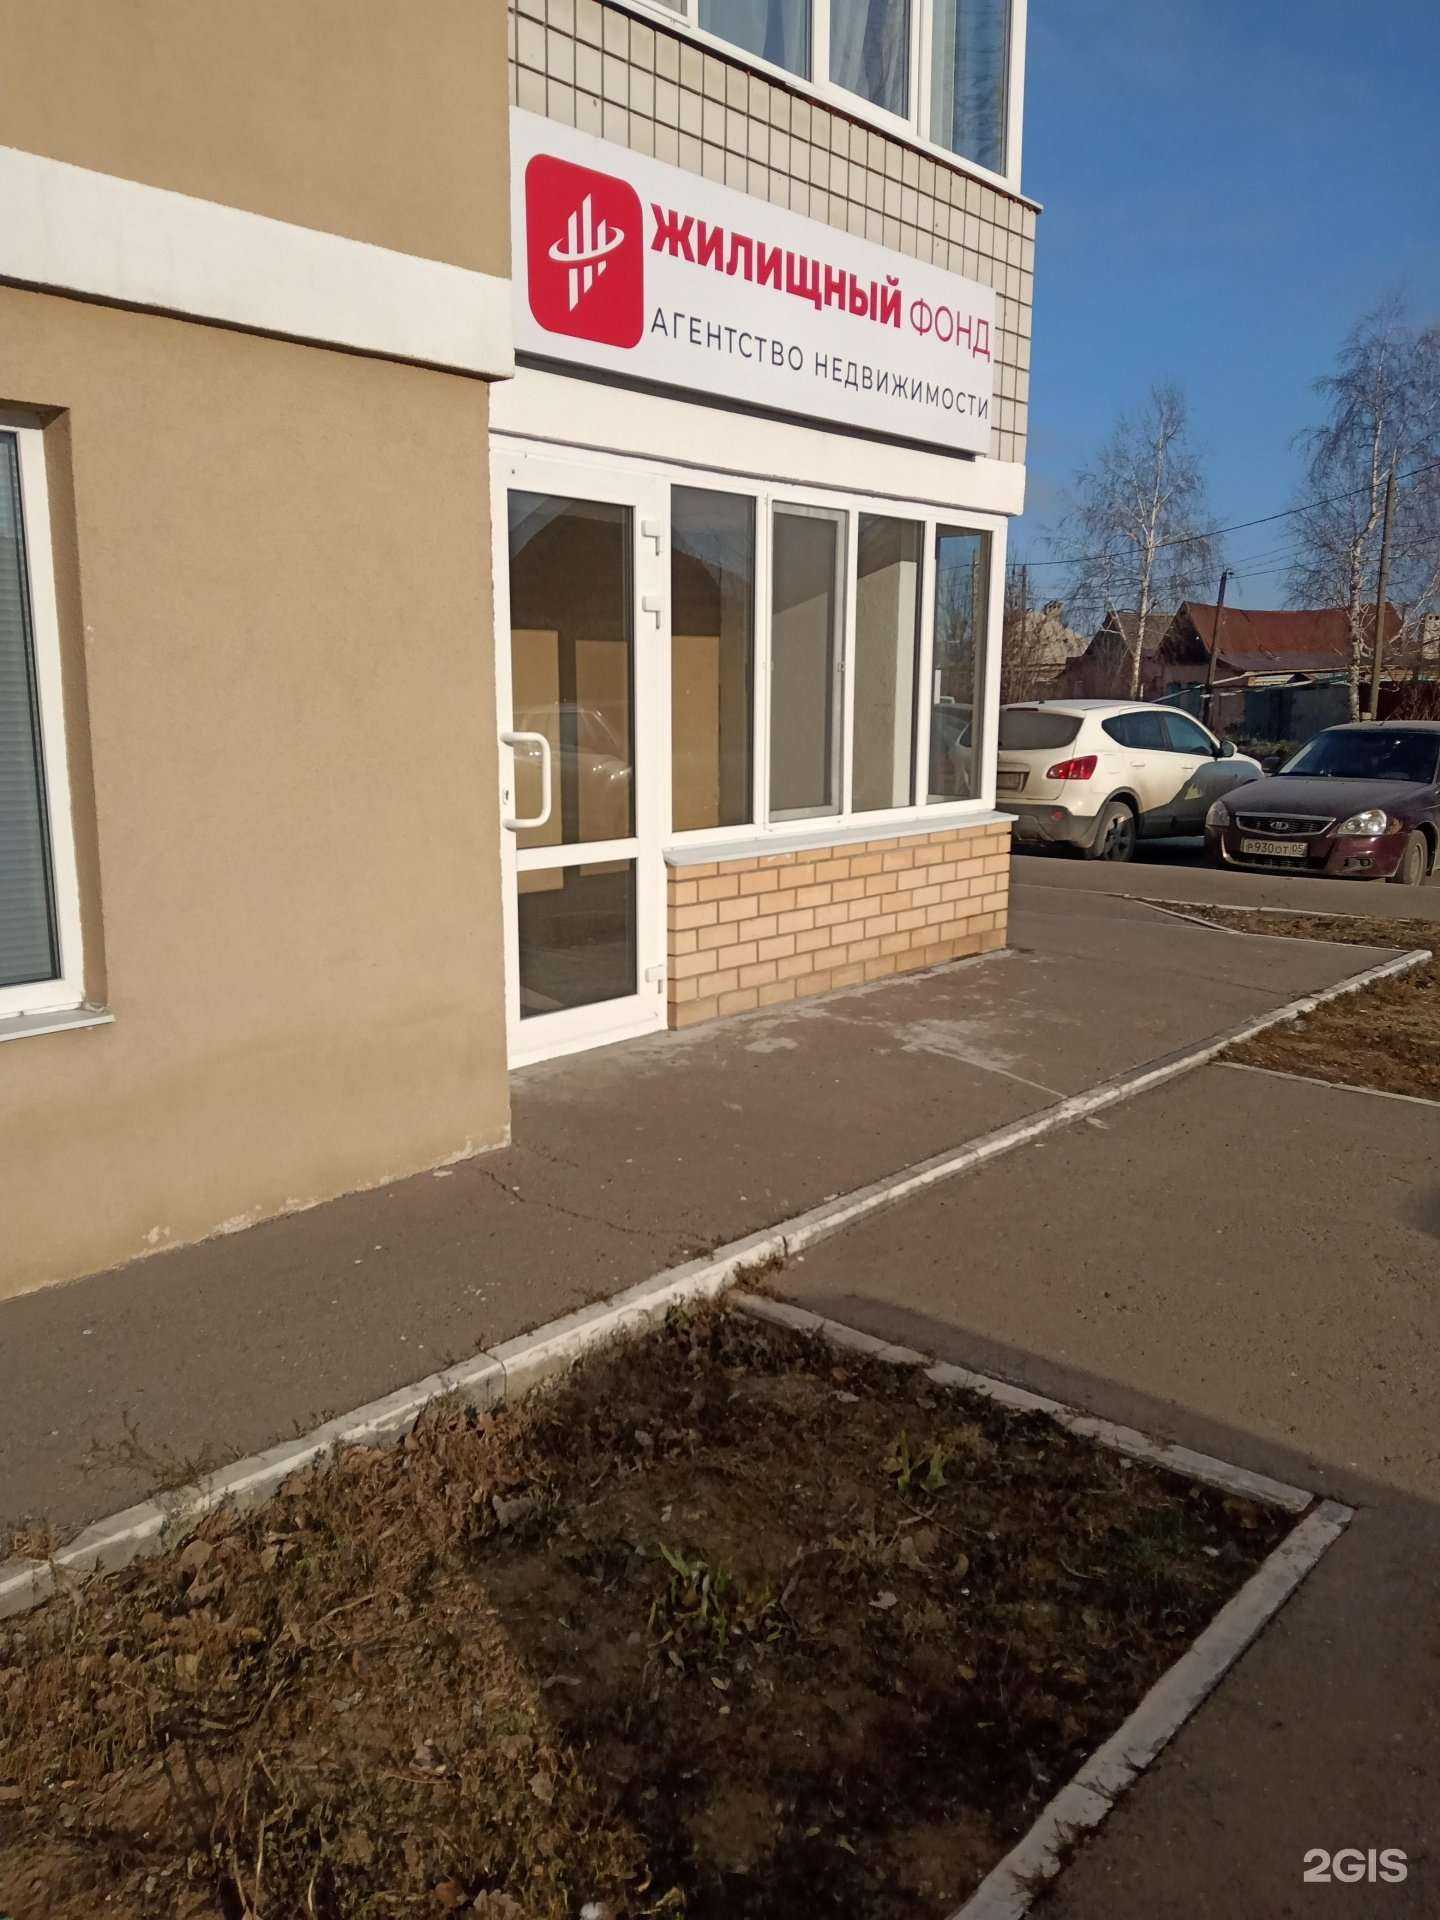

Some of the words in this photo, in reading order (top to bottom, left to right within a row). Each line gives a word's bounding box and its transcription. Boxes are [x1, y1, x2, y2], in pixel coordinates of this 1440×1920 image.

[651, 203, 901, 328] ЖИЛИЩНЫЙ
[910, 298, 990, 363] ФОНД
[651, 307, 803, 371] АГЕНТСТВО
[815, 352, 988, 419] НЕДВИЖИМОСТИ
